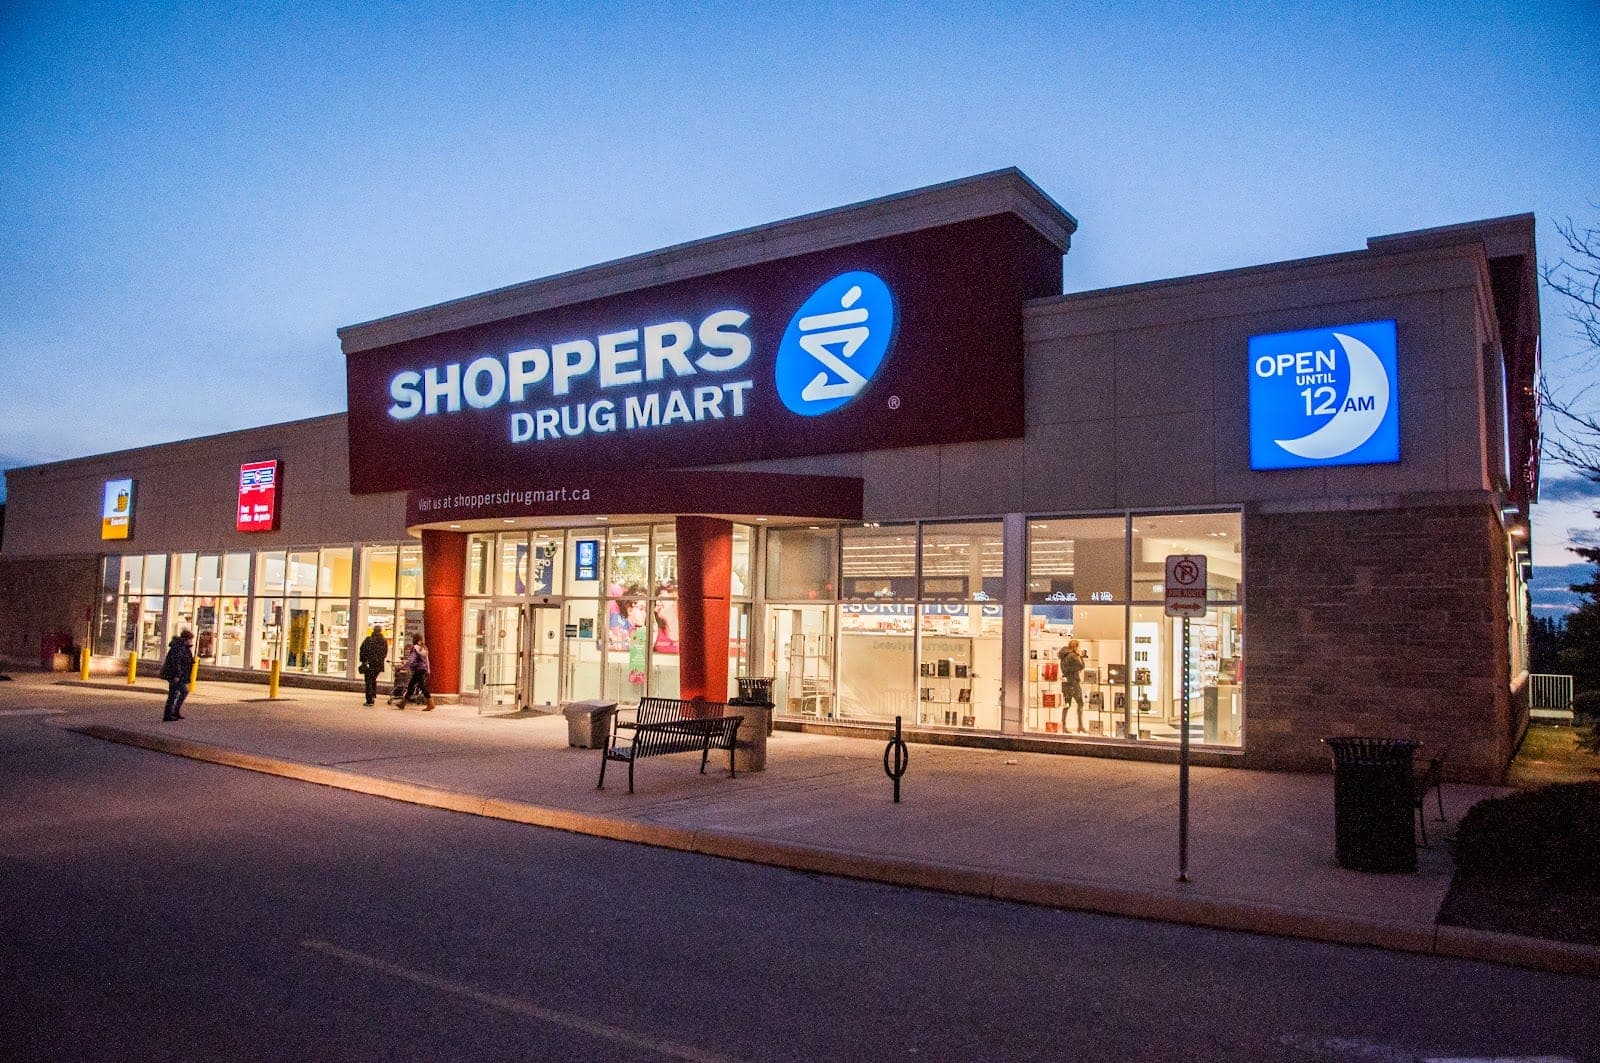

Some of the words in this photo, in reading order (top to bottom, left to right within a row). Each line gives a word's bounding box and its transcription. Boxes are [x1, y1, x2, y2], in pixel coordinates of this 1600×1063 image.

[388, 310, 751, 420] SHOPPERS
[1255, 349, 1336, 378] OPEN
[1296, 373, 1336, 386] UNTIL
[511, 400, 617, 444] DRUG
[625, 380, 753, 430] MART
[1301, 386, 1337, 416] 12
[1344, 396, 1375, 413] AM
[433, 499, 441, 509] us
[443, 495, 451, 508] at
[454, 487, 590, 508] shoppersdrugmart.ca
